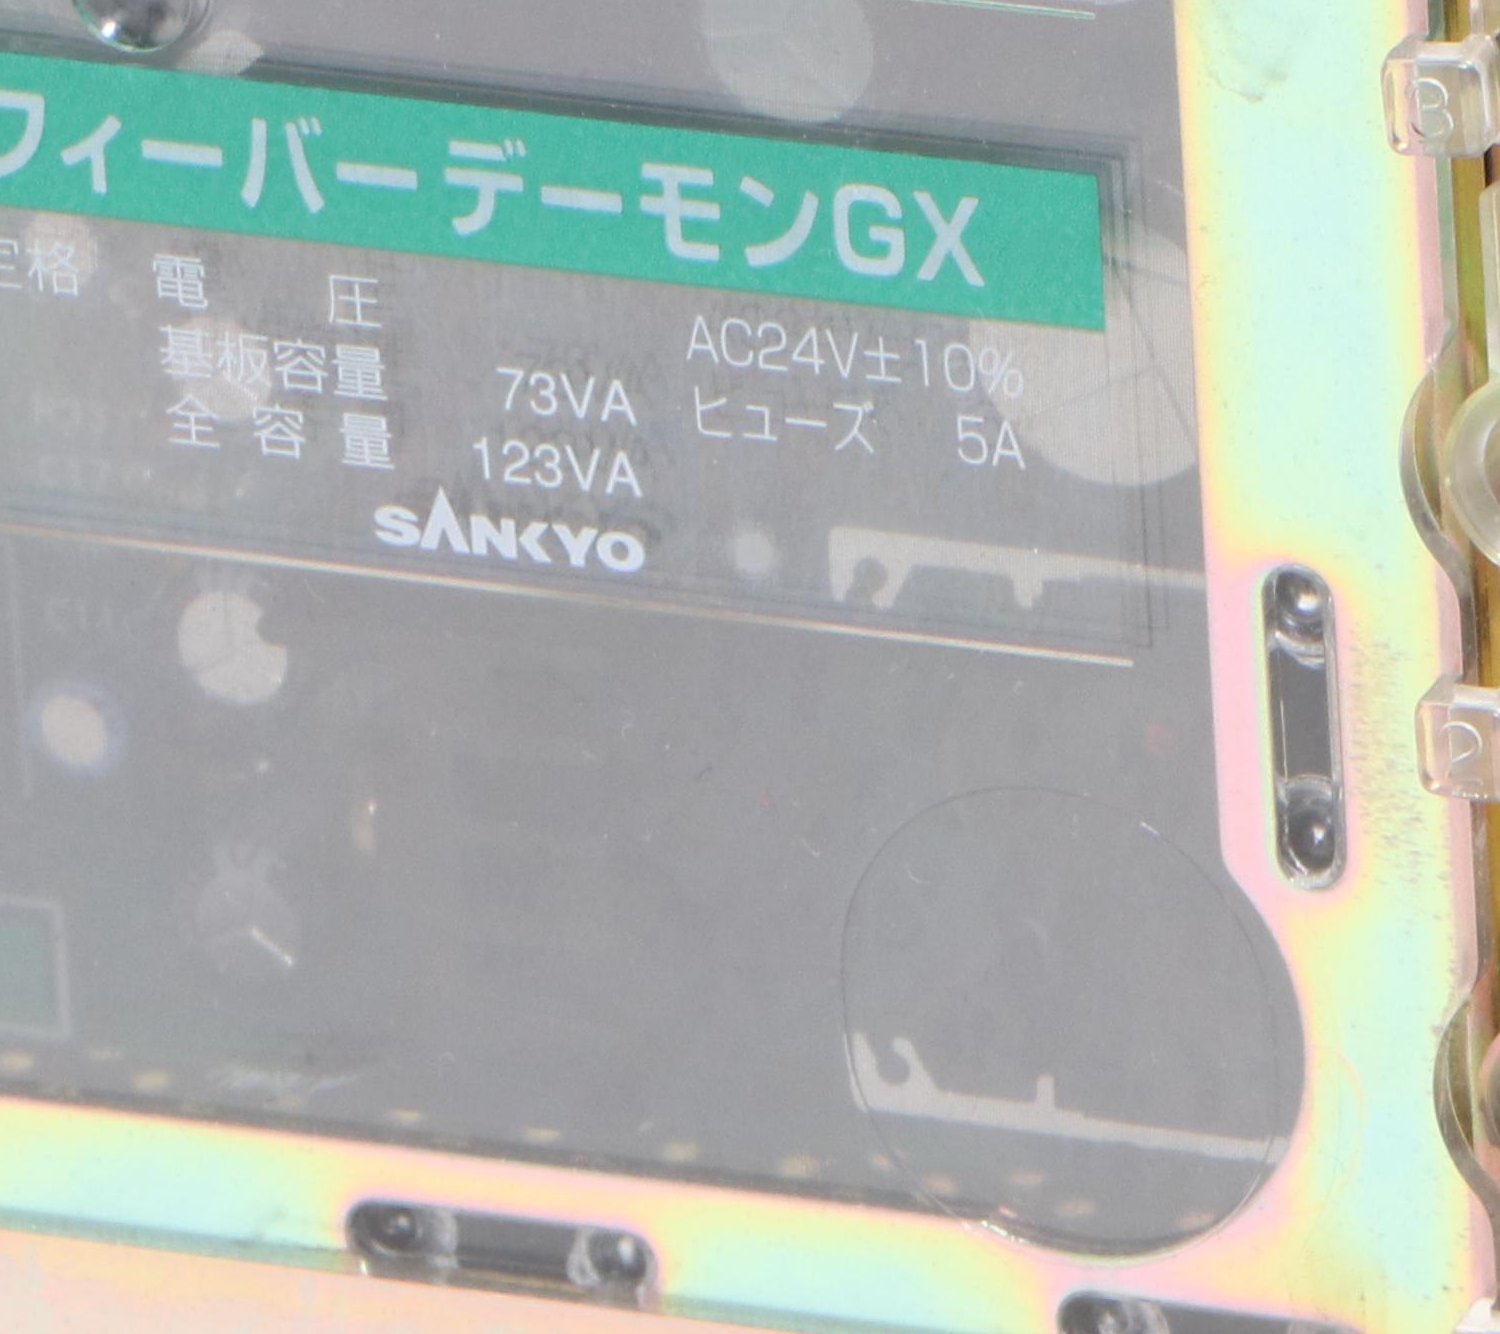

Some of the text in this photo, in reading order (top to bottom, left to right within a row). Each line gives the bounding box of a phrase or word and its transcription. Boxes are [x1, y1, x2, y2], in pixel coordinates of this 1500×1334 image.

[159, 323, 638, 428] 基板容量 73VA
[686, 315, 1025, 401] AC24V±10%
[473, 435, 644, 499] 123VA
[691, 385, 1027, 469] ヒューズ 5A
[374, 488, 646, 574] SANKYO
